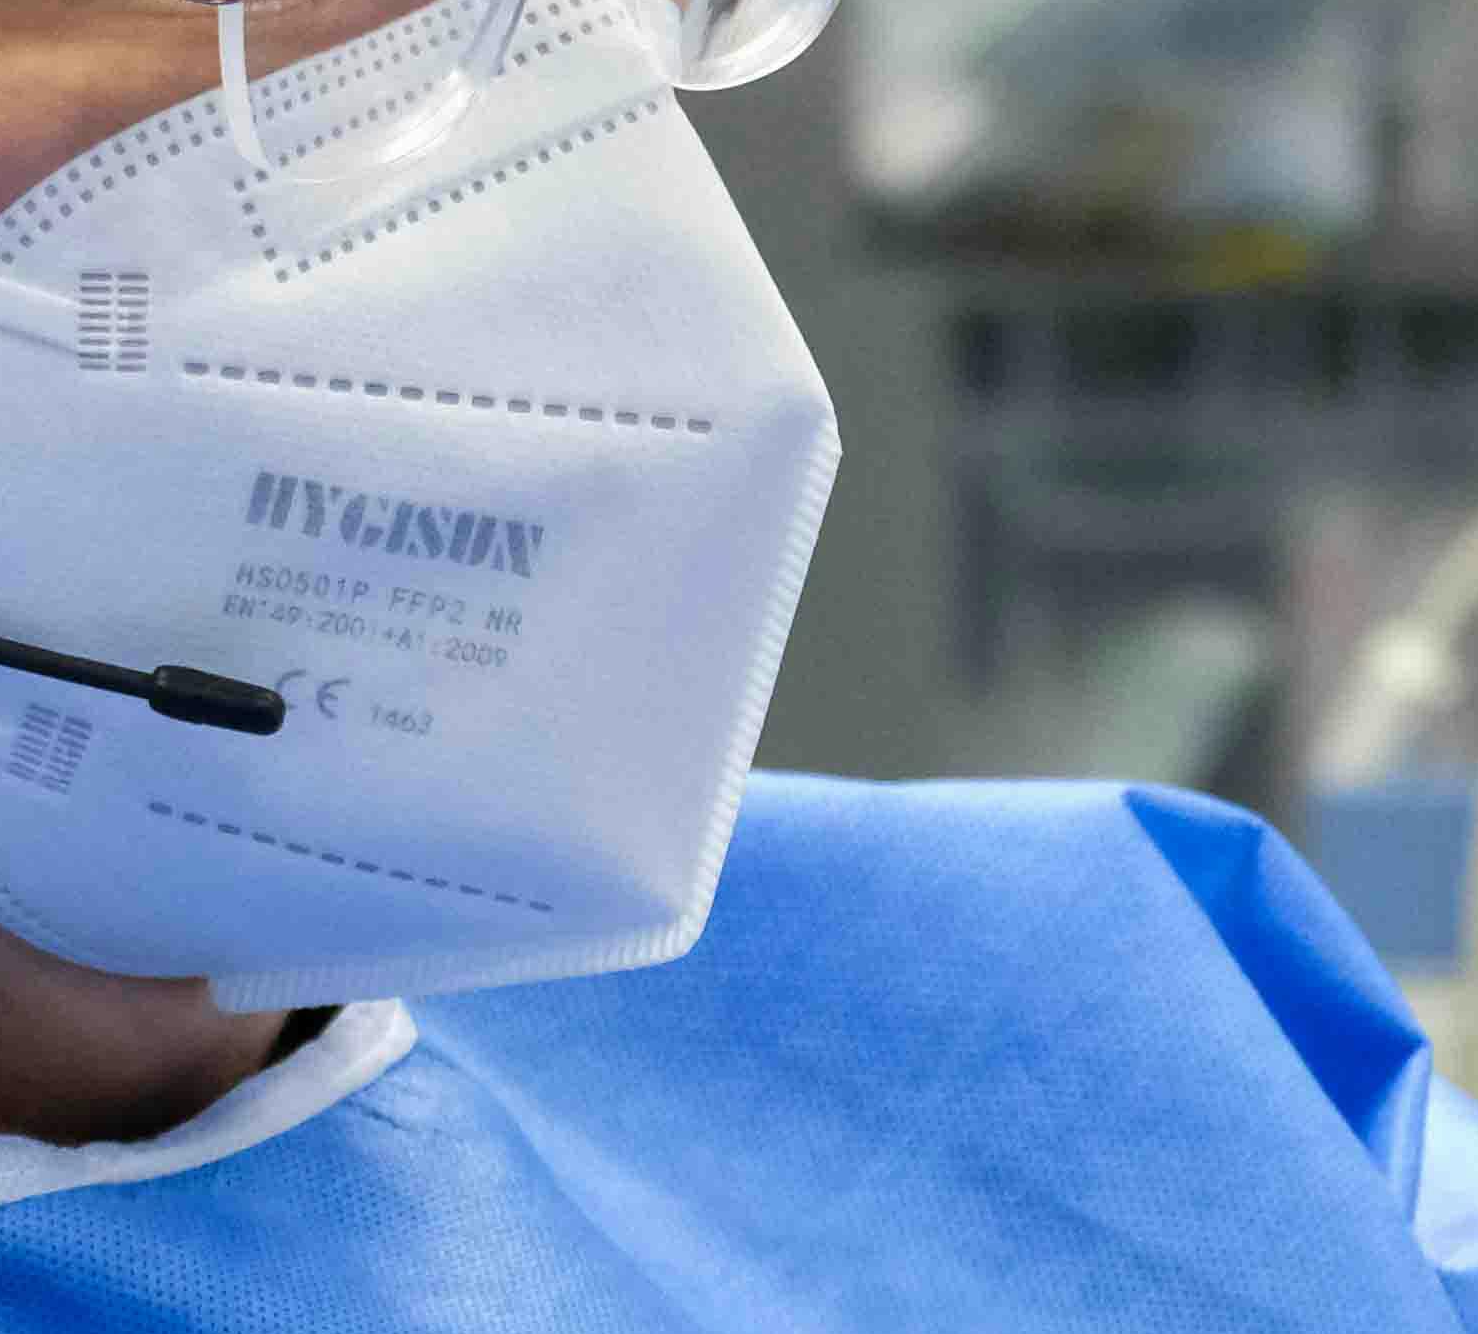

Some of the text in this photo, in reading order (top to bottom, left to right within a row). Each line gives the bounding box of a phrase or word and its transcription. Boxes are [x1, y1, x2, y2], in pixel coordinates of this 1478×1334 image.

[246, 471, 544, 578] HYGISUN
[387, 585, 467, 625] FFP2
[483, 606, 523, 636] NR
